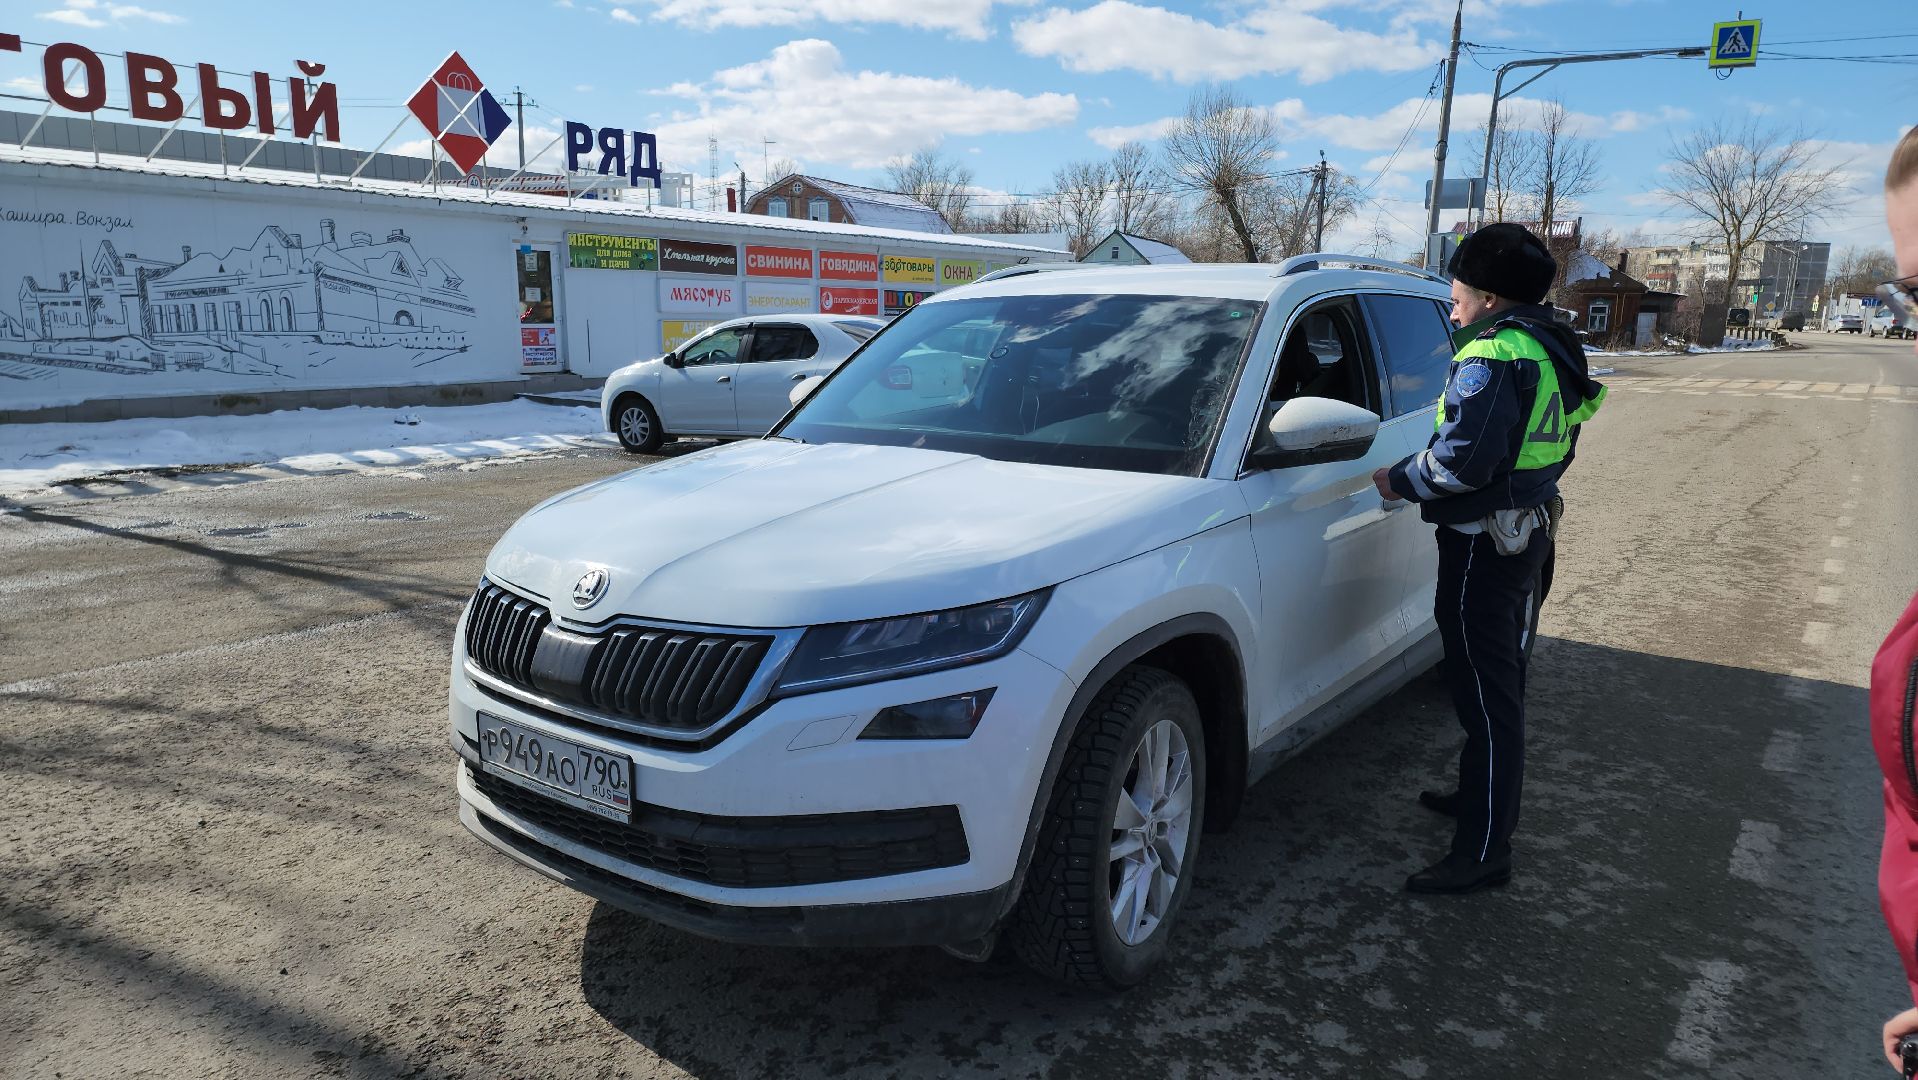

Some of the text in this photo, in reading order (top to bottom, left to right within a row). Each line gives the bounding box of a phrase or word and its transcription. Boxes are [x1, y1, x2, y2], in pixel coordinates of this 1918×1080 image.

[0, 33, 340, 142] ОВЫЙ
[566, 120, 661, 188] РЯД
[76, 210, 134, 232] Вокзал
[568, 234, 657, 250] ИНСТРУМЕНТЫ
[747, 254, 811, 271] СВИНИНА
[821, 258, 877, 274] ГОВЯДИНА
[885, 259, 935, 274] ЗООТОВАРЫ
[944, 264, 974, 281] ОКНА
[748, 295, 811, 309] ЭНЕРГОГАРАНТ
[580, 751, 621, 789] 790
[592, 784, 612, 800] RUS
